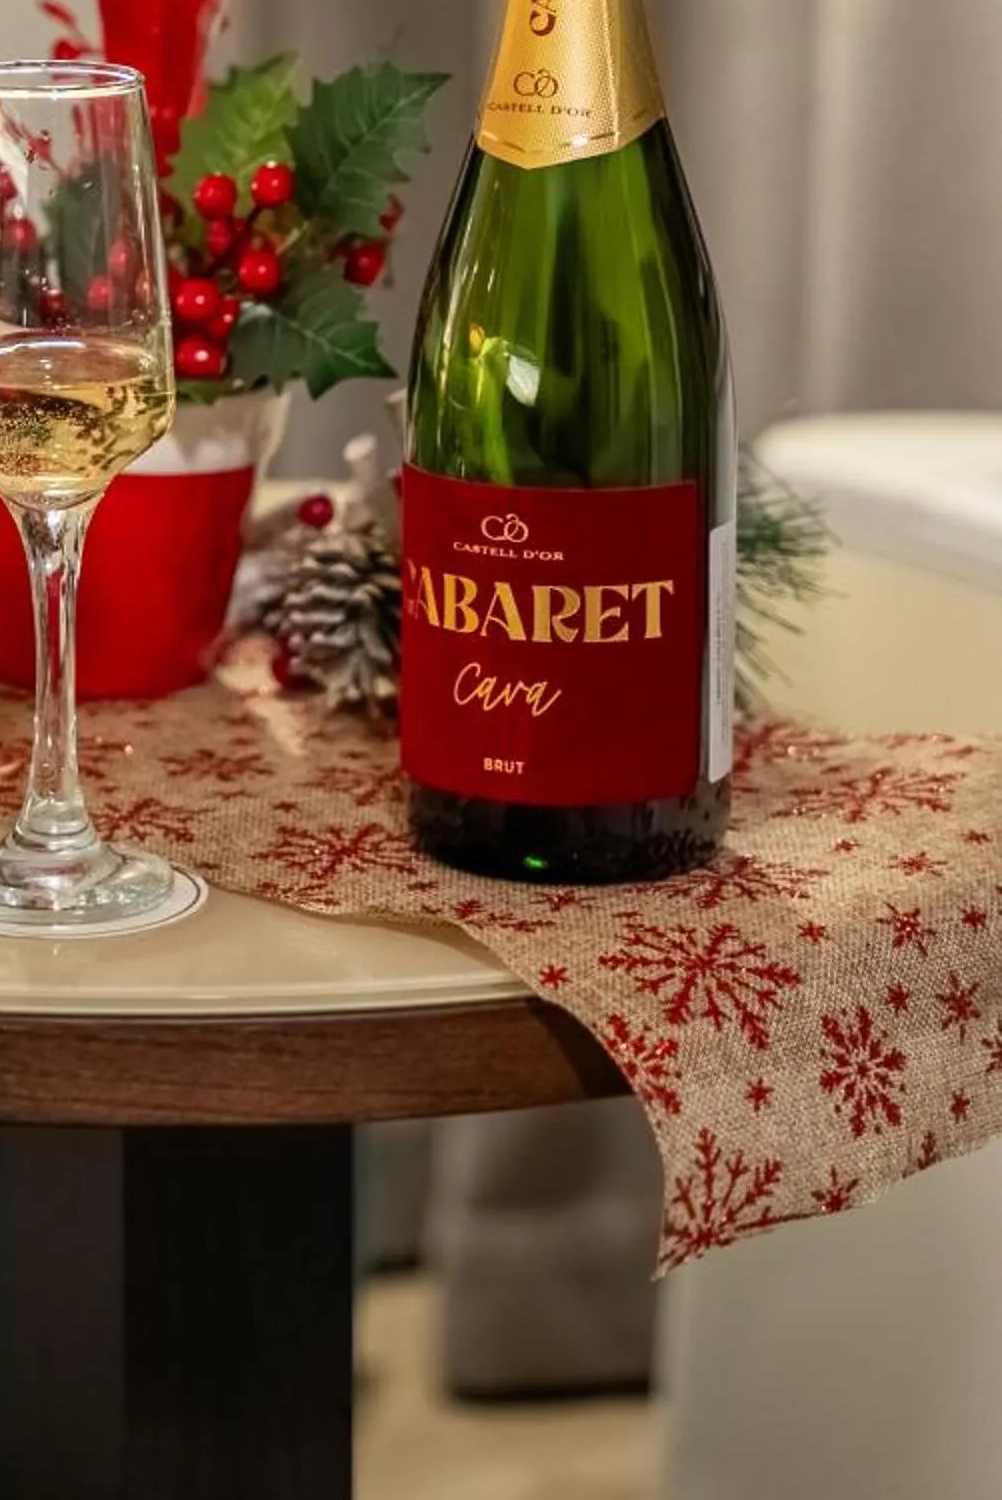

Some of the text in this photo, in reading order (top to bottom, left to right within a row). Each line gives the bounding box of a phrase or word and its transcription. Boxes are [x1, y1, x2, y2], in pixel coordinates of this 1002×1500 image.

[453, 541, 564, 561] CASTELL D'OR
[453, 662, 562, 717] Cava
[484, 757, 525, 775] BRUT
